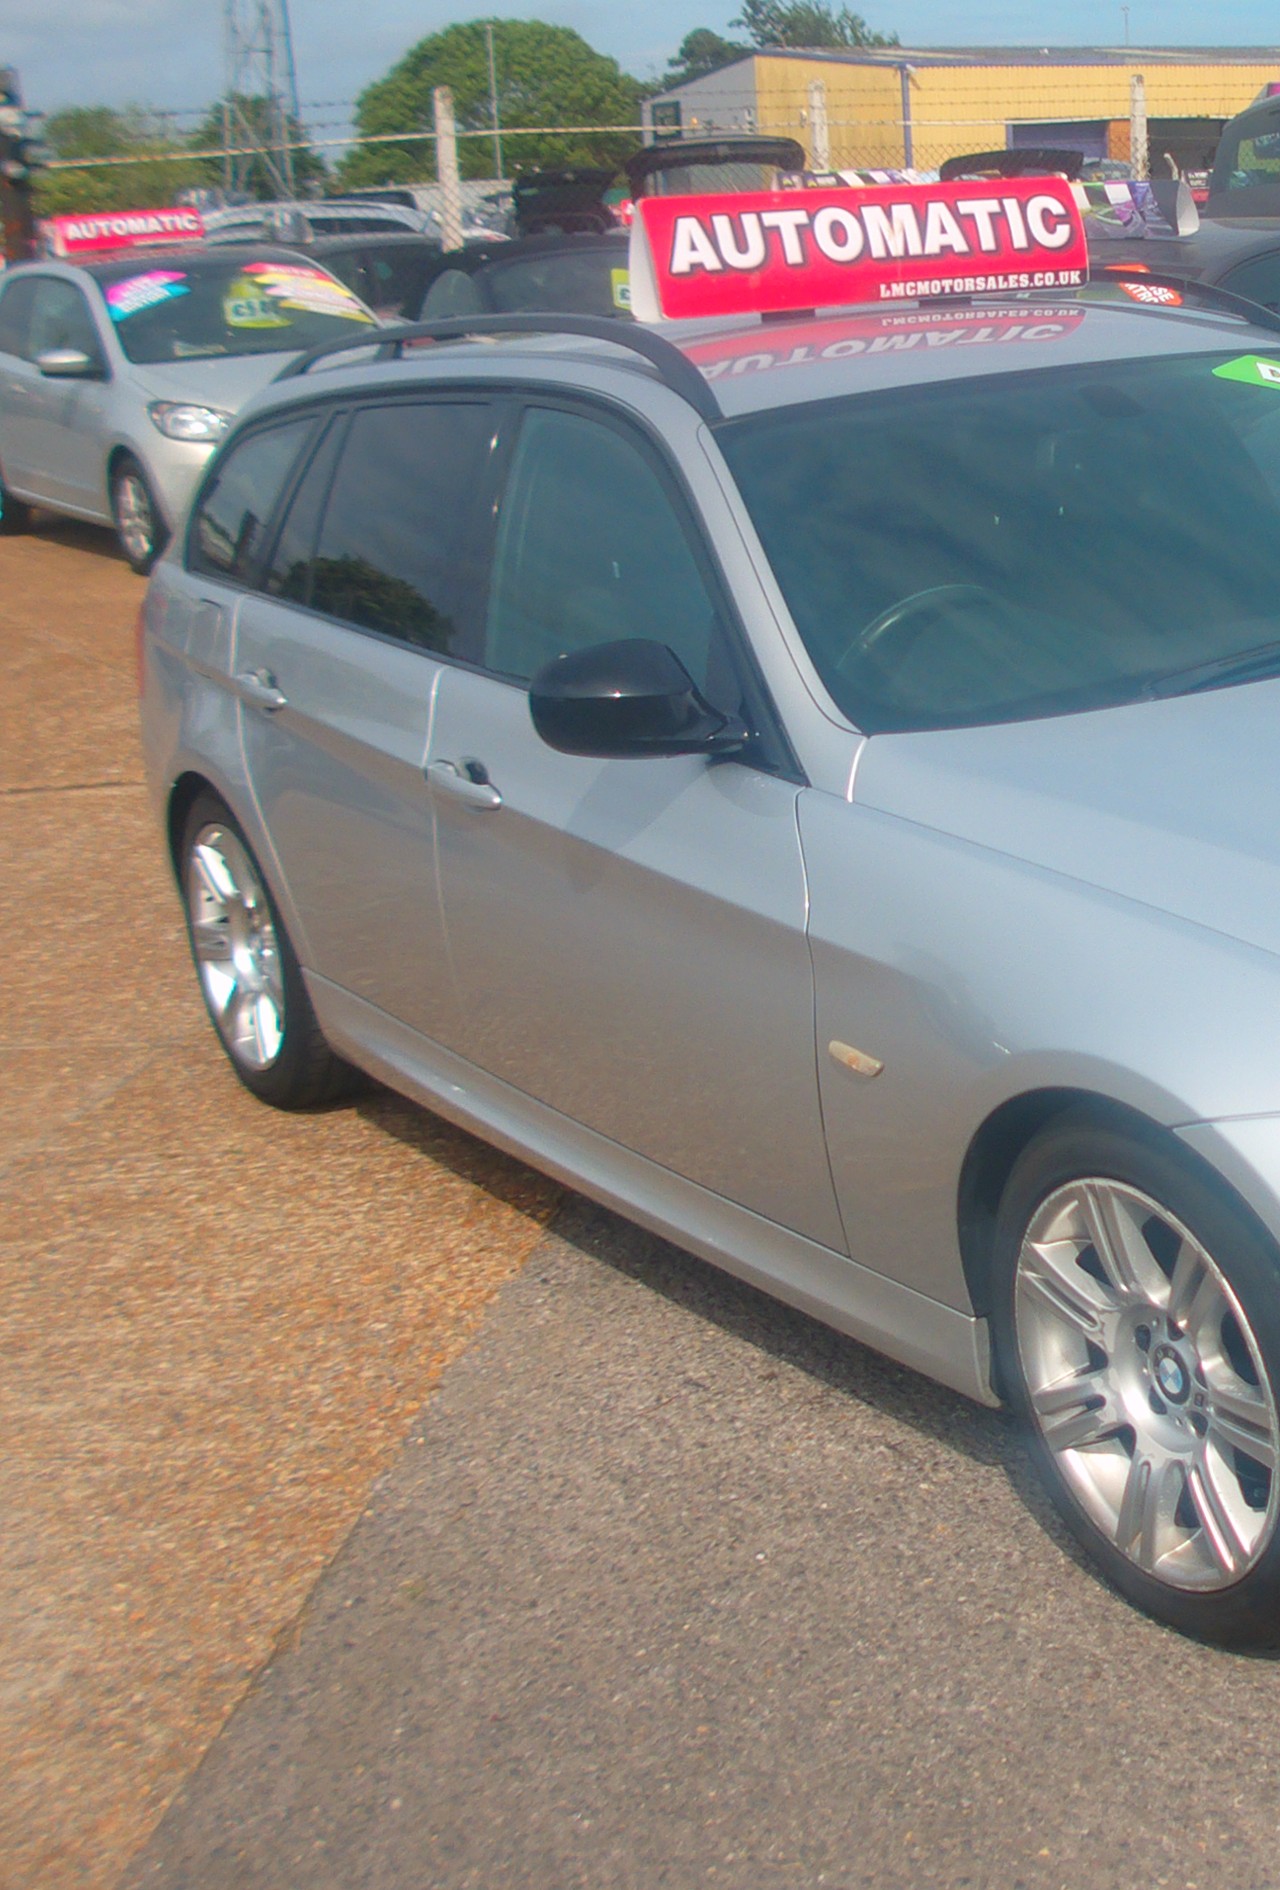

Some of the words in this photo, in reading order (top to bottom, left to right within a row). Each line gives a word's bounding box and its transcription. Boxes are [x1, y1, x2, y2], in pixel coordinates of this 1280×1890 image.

[66, 213, 200, 241] AUTOMATIC
[670, 194, 1071, 275] AUTOMATIC
[879, 270, 1082, 299] LMCMOTORSALES.CO.UK
